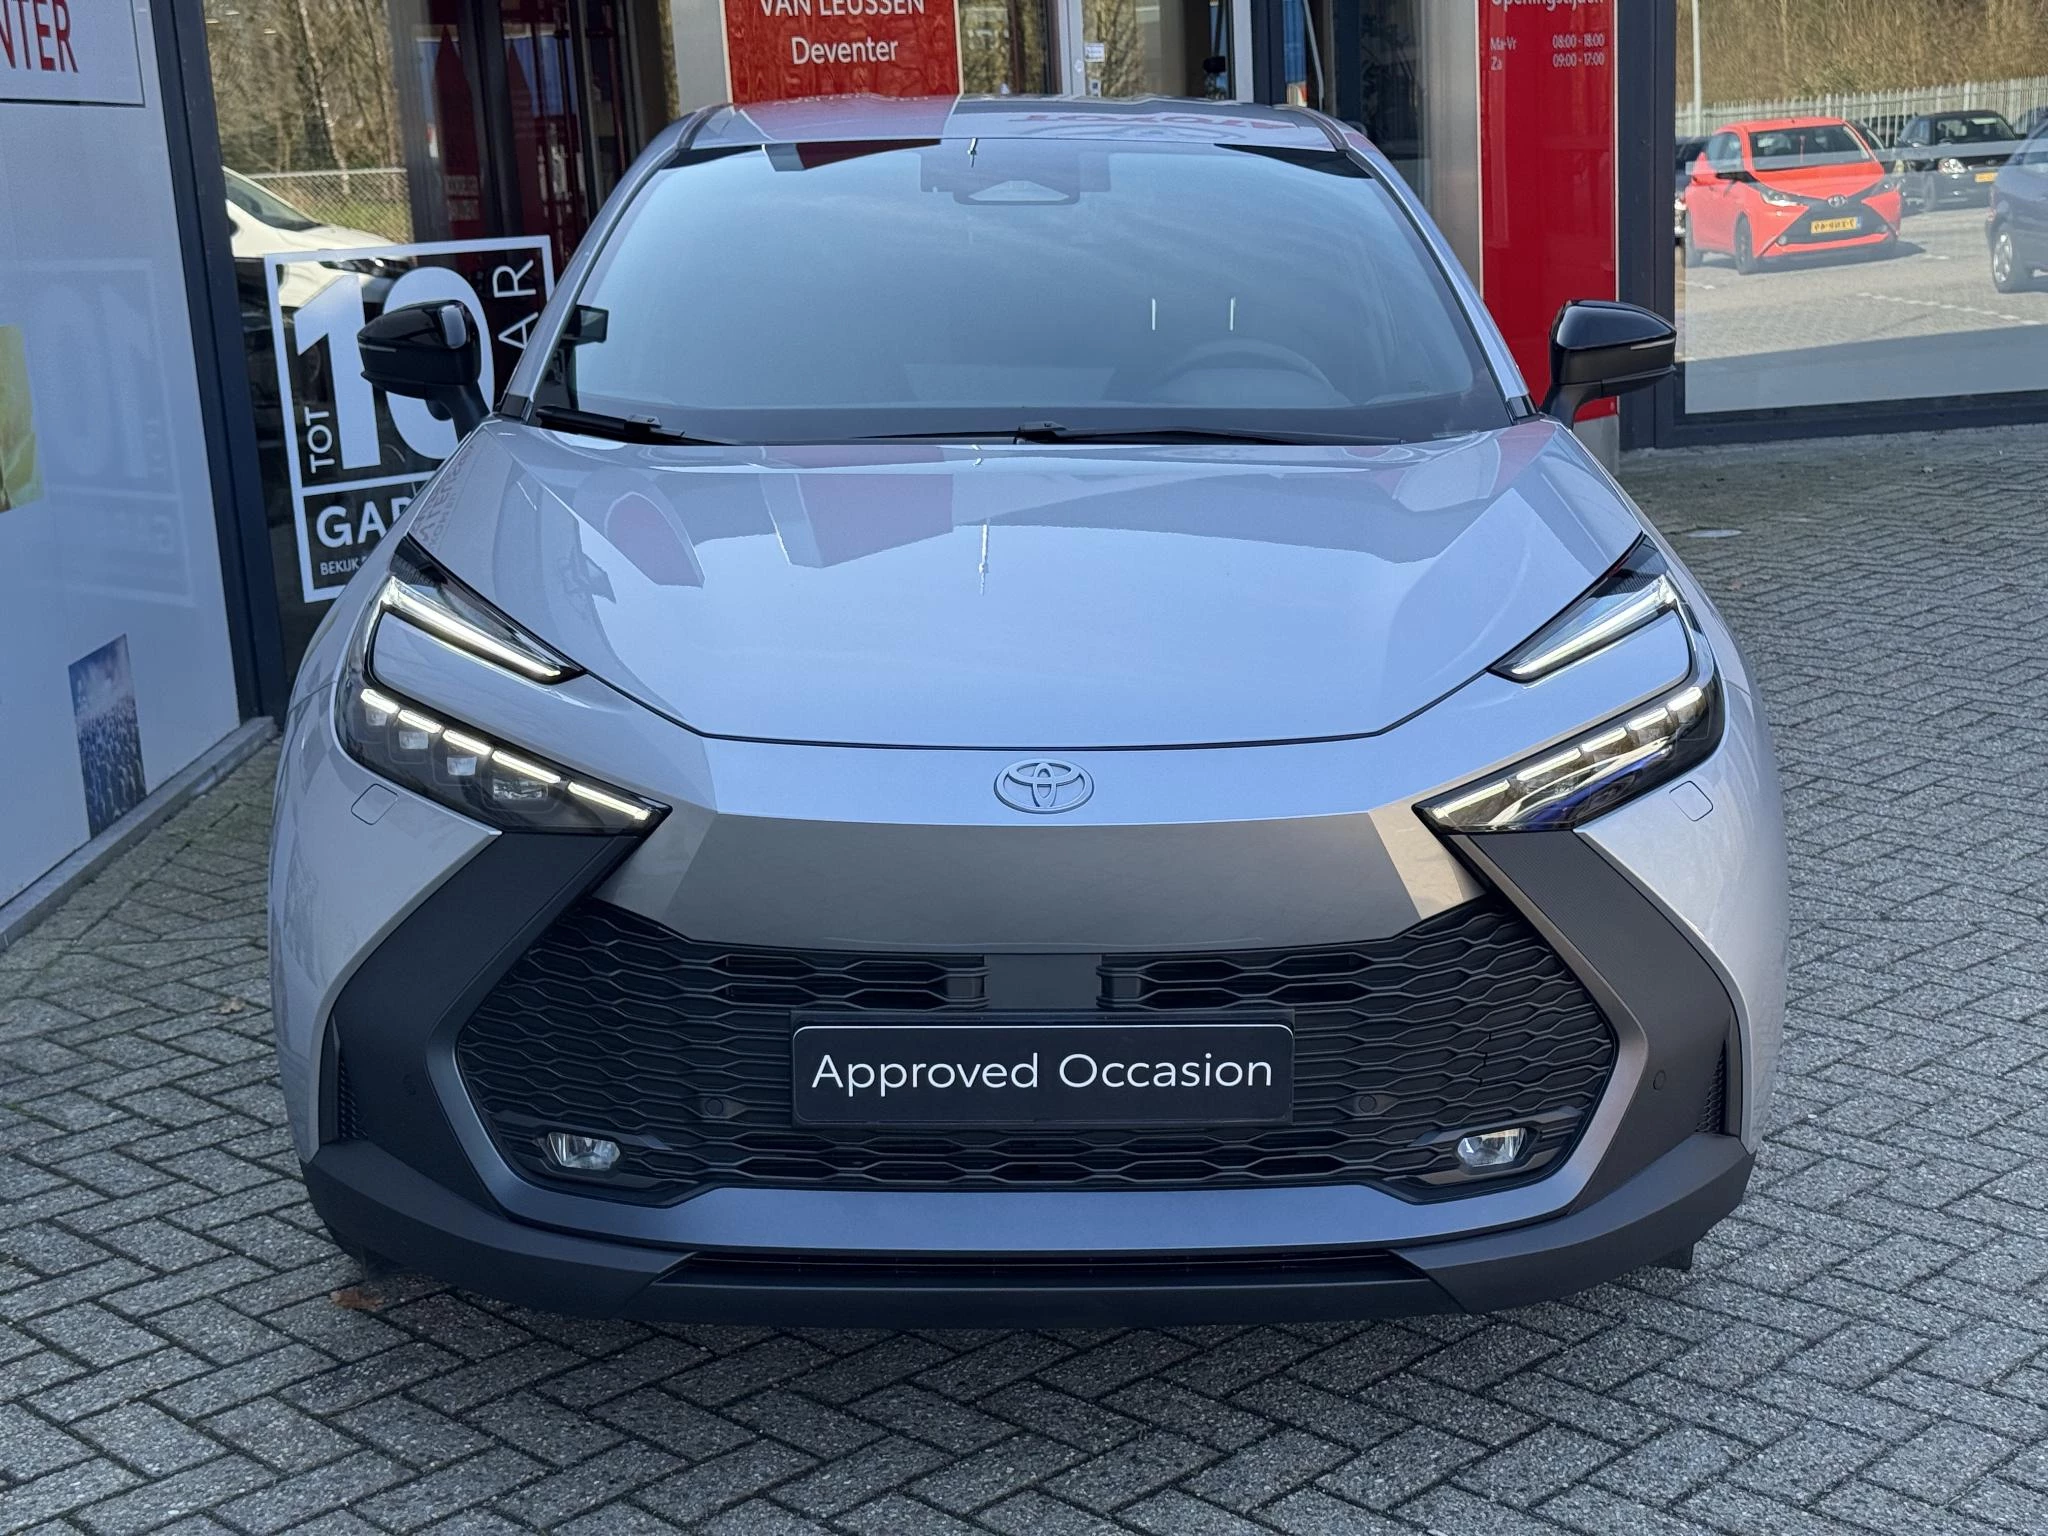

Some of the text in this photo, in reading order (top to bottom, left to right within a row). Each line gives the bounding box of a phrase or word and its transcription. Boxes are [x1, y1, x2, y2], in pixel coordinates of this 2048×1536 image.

[761, 0, 925, 16] VAN LEUSSEN
[791, 36, 899, 65] Deventer
[1552, 34, 1577, 49] 08:00
[1583, 33, 1605, 48] 18:00
[1490, 56, 1502, 71] Za
[1552, 53, 1577, 67] 09:00
[1583, 52, 1605, 66] 17:00
[293, 266, 495, 470] 10
[304, 406, 335, 474] TOT
[811, 1052, 1272, 1098] Approved Occasion
